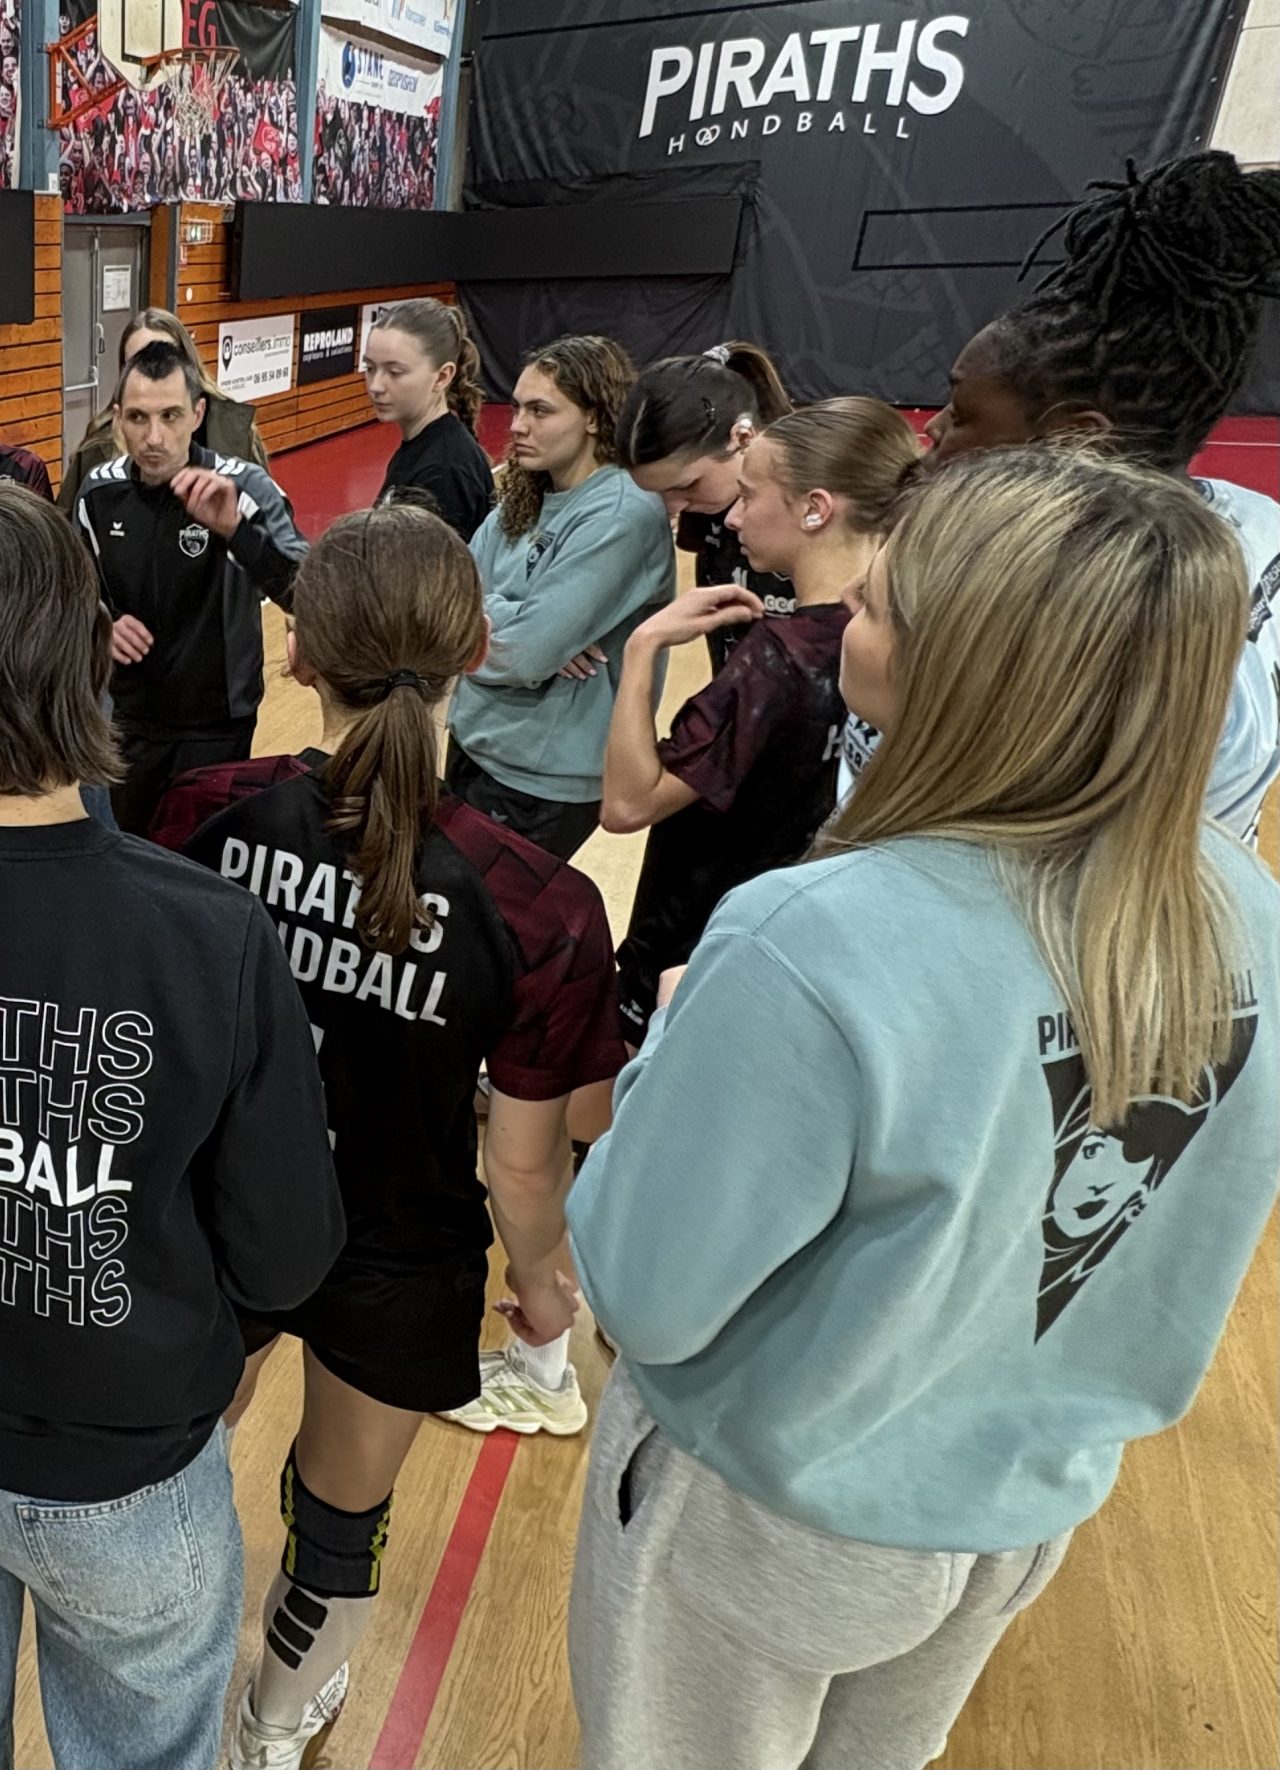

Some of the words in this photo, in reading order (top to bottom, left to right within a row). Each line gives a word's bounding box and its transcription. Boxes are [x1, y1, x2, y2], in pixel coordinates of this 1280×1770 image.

[638, 15, 969, 139] PIRATHS
[303, 326, 354, 352] REPROLAND
[221, 837, 450, 953] PIRATS
